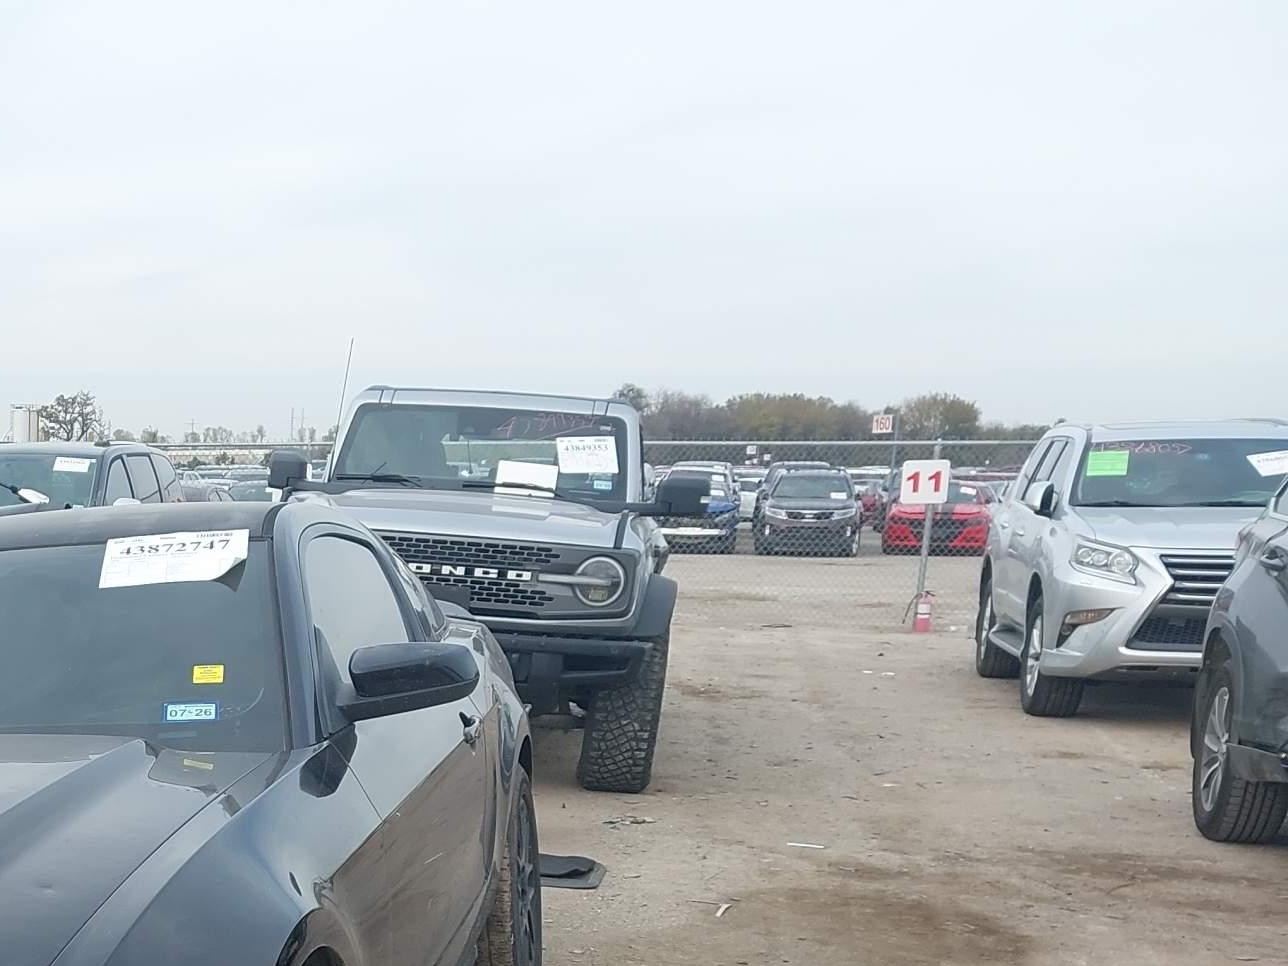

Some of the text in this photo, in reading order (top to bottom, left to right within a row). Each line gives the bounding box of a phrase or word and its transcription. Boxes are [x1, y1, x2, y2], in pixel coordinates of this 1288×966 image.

[875, 416, 891, 431] 160
[906, 470, 943, 494] 11
[119, 539, 231, 556] 43872747
[408, 562, 532, 580] ONCO
[169, 708, 213, 718] 07-26
